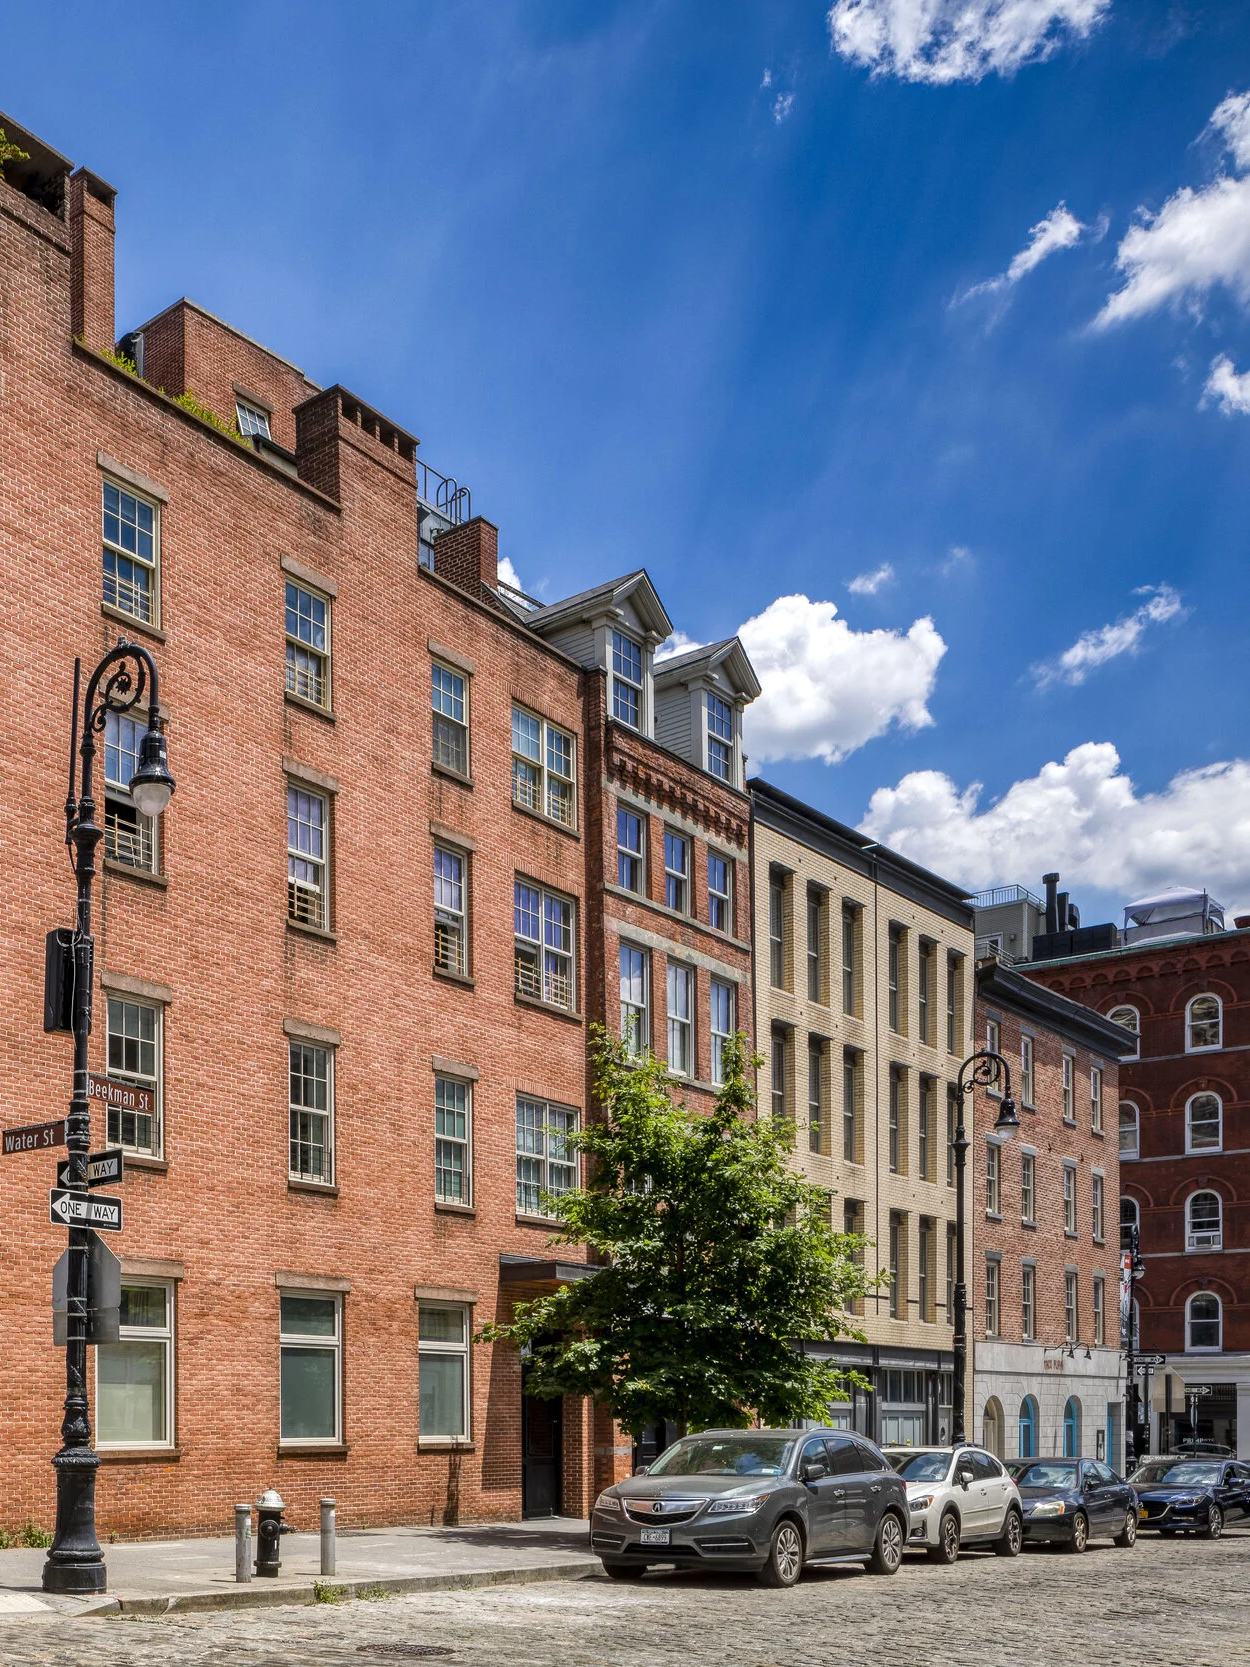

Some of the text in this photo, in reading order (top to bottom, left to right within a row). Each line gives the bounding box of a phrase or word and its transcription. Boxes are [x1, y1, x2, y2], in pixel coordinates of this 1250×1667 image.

[89, 1079, 135, 1107] Beekman
[138, 1093, 149, 1110] St
[5, 1133, 39, 1152] Water
[43, 1128, 54, 1146] St
[93, 1158, 114, 1176] WAY
[60, 1201, 116, 1223] ONE WAY
